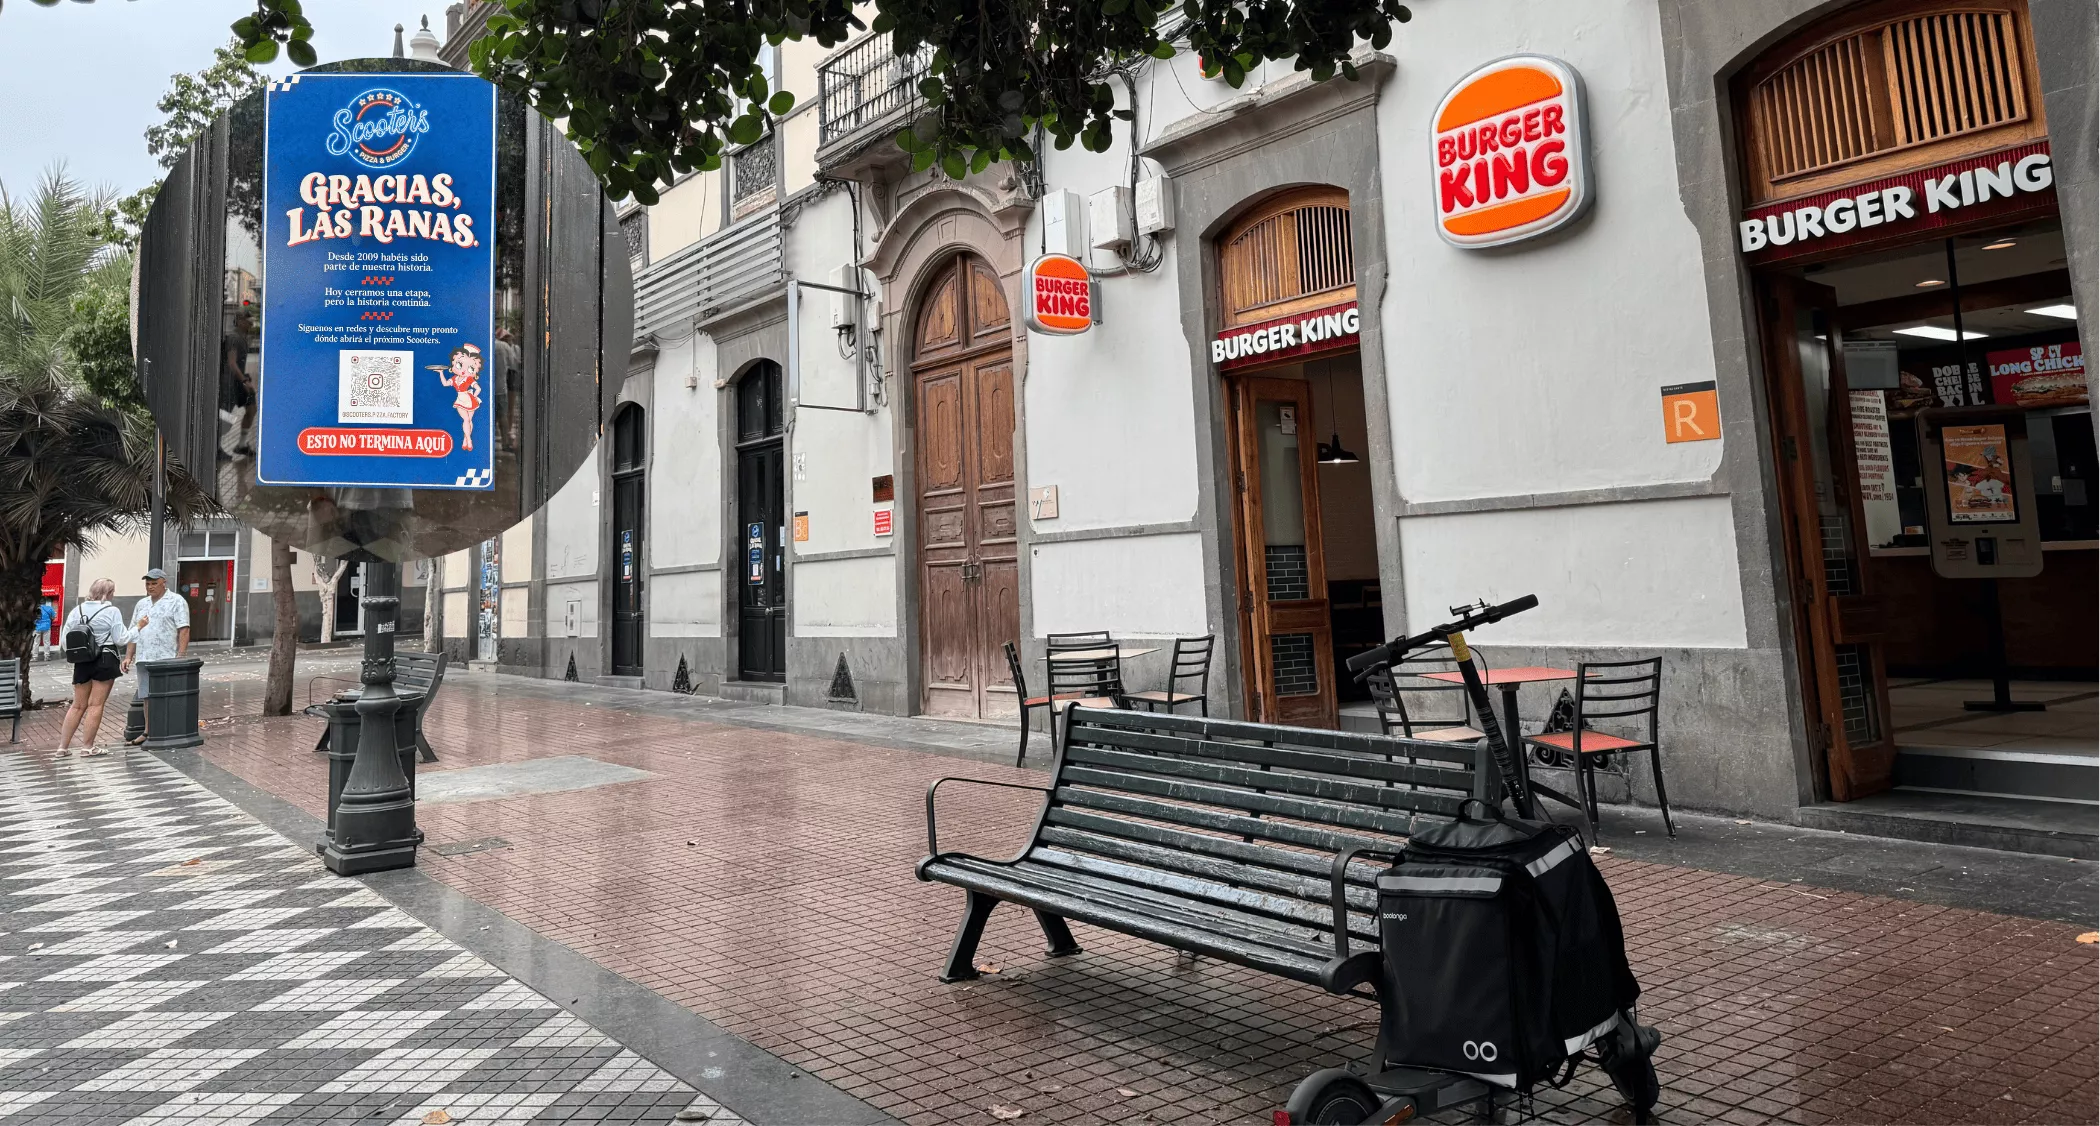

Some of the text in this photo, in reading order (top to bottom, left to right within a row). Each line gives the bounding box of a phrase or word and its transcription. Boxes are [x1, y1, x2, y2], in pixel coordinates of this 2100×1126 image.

[1438, 103, 1565, 168] BURGER
[359, 151, 378, 163] PIZZA
[386, 143, 409, 163] BURGER
[1440, 138, 1568, 213] KING
[300, 171, 461, 212] GRACIAS,
[1740, 153, 2053, 253] BURGER KING
[286, 205, 479, 248] LAS RANAS.
[324, 263, 347, 272] parte
[349, 262, 360, 271] de
[398, 263, 433, 272] historia.
[327, 252, 428, 262] Desde 2009 habéis sido
[325, 288, 342, 298] Hoy
[345, 289, 385, 297] cerramos
[405, 290, 431, 298] etapa,
[1036, 278, 1088, 296] BURGER
[324, 298, 431, 307] pero la historia continúa.
[1037, 294, 1089, 317] KING
[314, 334, 441, 345] dónde abrirá el próximo Scooters.
[346, 325, 367, 333] redes
[376, 325, 411, 333] descubre
[412, 327, 429, 335] muy
[431, 327, 458, 335] pronto
[1211, 308, 1359, 363] BURGER KING
[1932, 362, 1979, 378] DOBE
[1989, 361, 2032, 377] LONG
[1674, 400, 1704, 437] R
[306, 434, 446, 454] ESTO NO TERMINA AQUÍ
